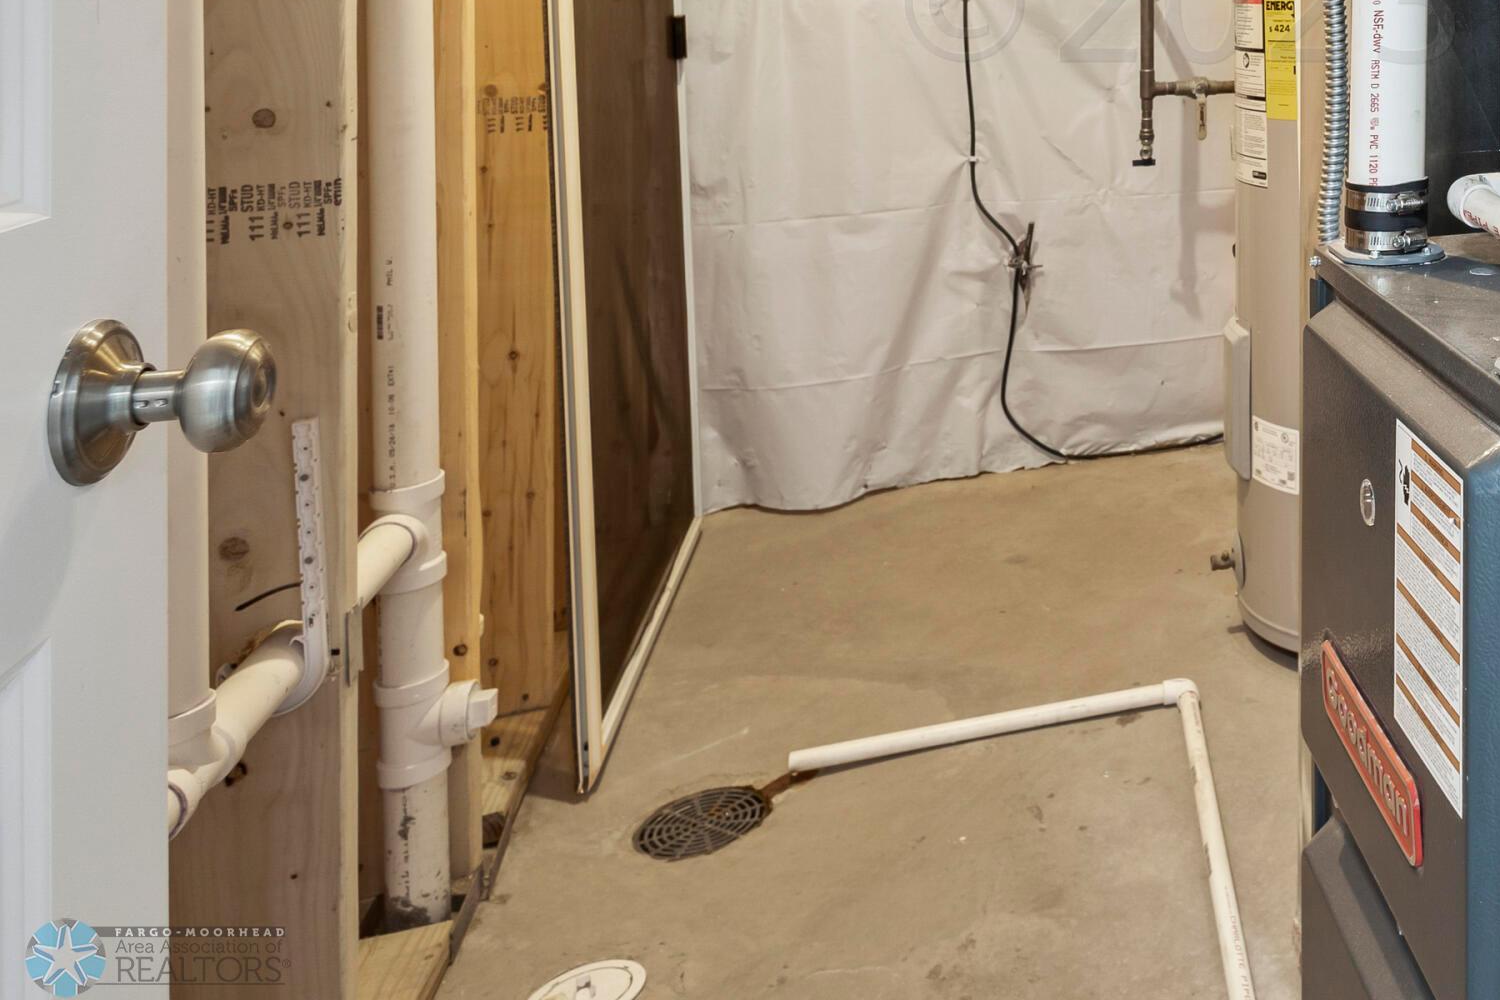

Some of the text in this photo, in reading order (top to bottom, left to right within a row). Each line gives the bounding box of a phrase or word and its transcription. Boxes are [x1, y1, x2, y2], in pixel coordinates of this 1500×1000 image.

[1274, 24, 1290, 33] 424
[1370, 59, 1380, 80] ASTM
[1370, 93, 1379, 113] 2665
[1369, 134, 1379, 149] PVC
[1369, 155, 1378, 173] 1120
[241, 184, 254, 213] STUD
[256, 184, 266, 212] KD-HT
[288, 181, 302, 209] STUD
[303, 181, 313, 208] KD-HT
[248, 215, 265, 242] 111
[295, 212, 312, 238] 111
[1325, 667, 1409, 838] Goodman
